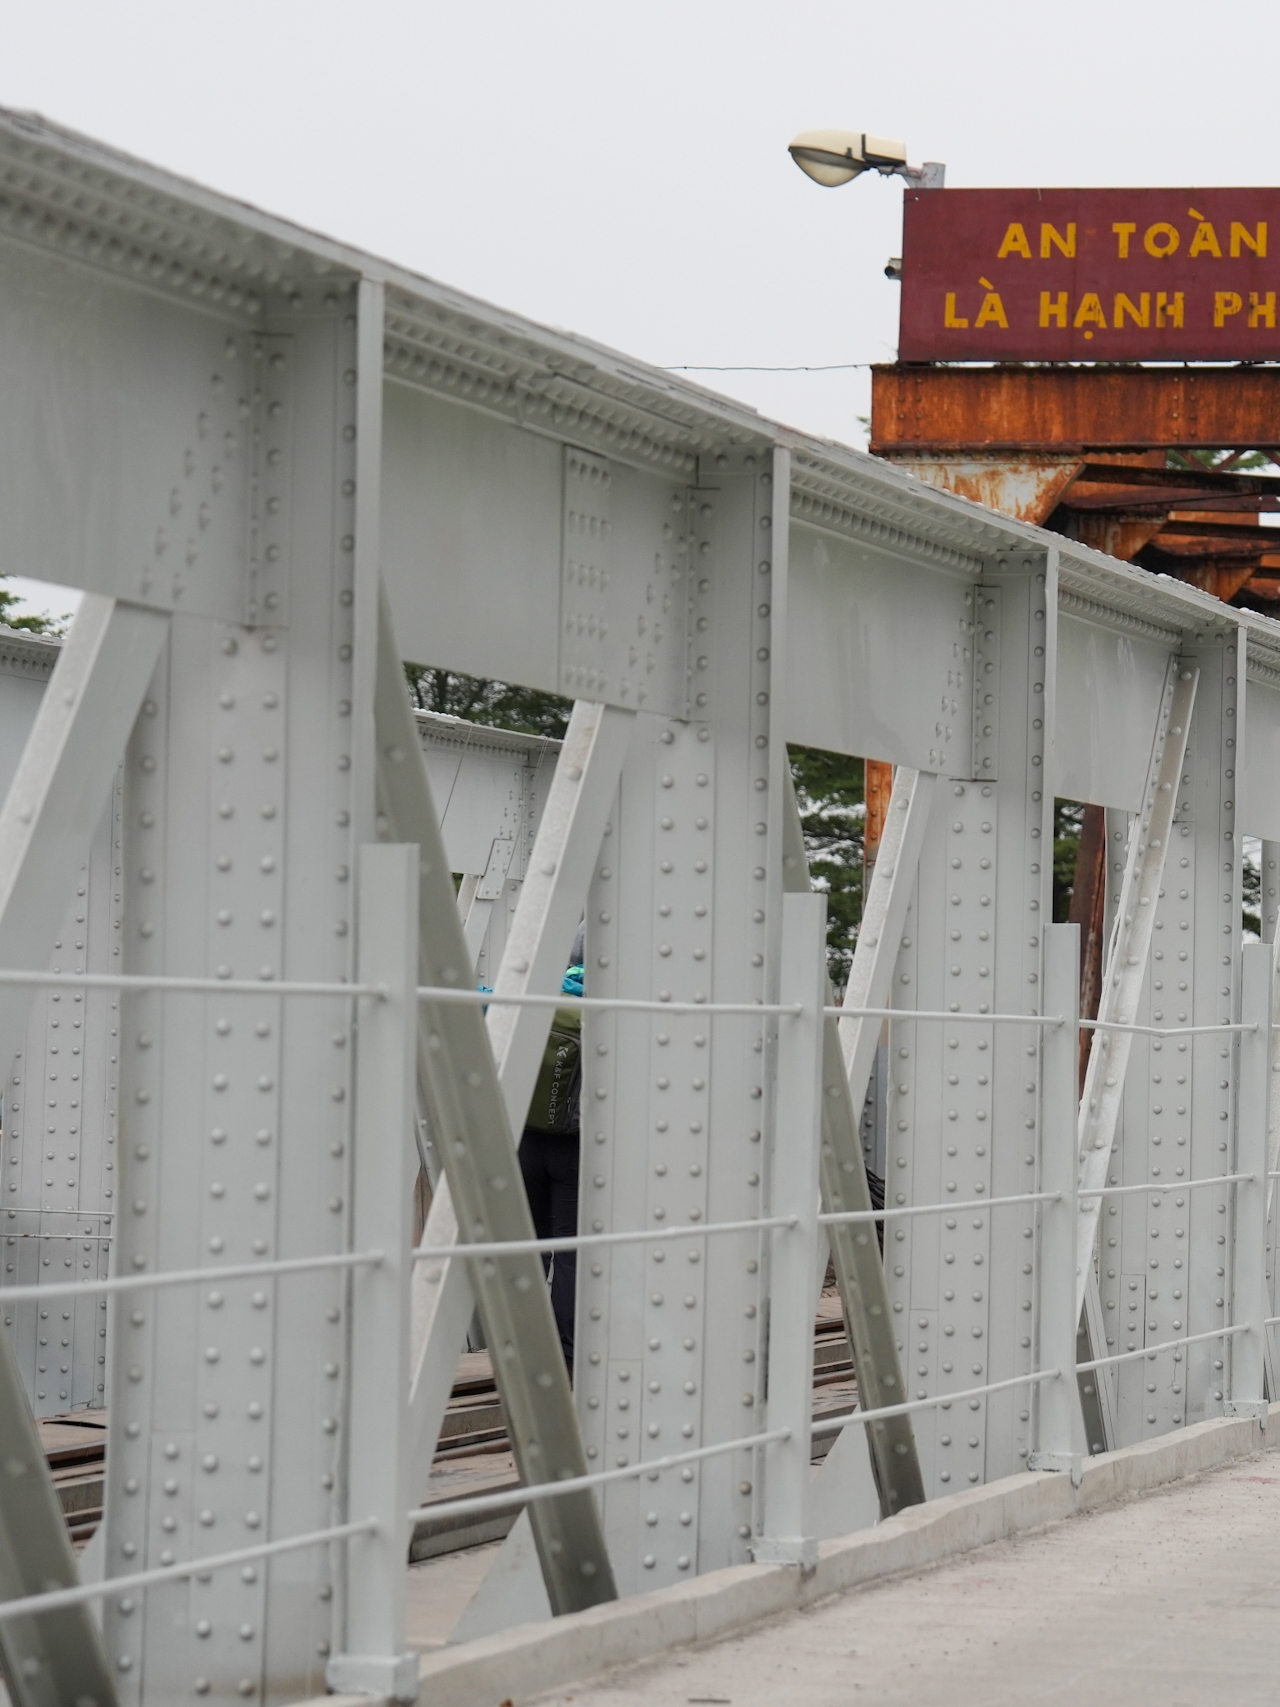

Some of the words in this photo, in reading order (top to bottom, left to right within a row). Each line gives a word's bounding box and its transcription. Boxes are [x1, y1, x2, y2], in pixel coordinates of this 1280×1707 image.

[997, 222, 1077, 259] AN
[1112, 207, 1268, 259] TOÀN
[944, 277, 1009, 329] LÀ
[1039, 291, 1185, 341] HẠNH
[554, 1060, 563, 1079] K&F
[547, 1081, 560, 1125] CONCEPT
